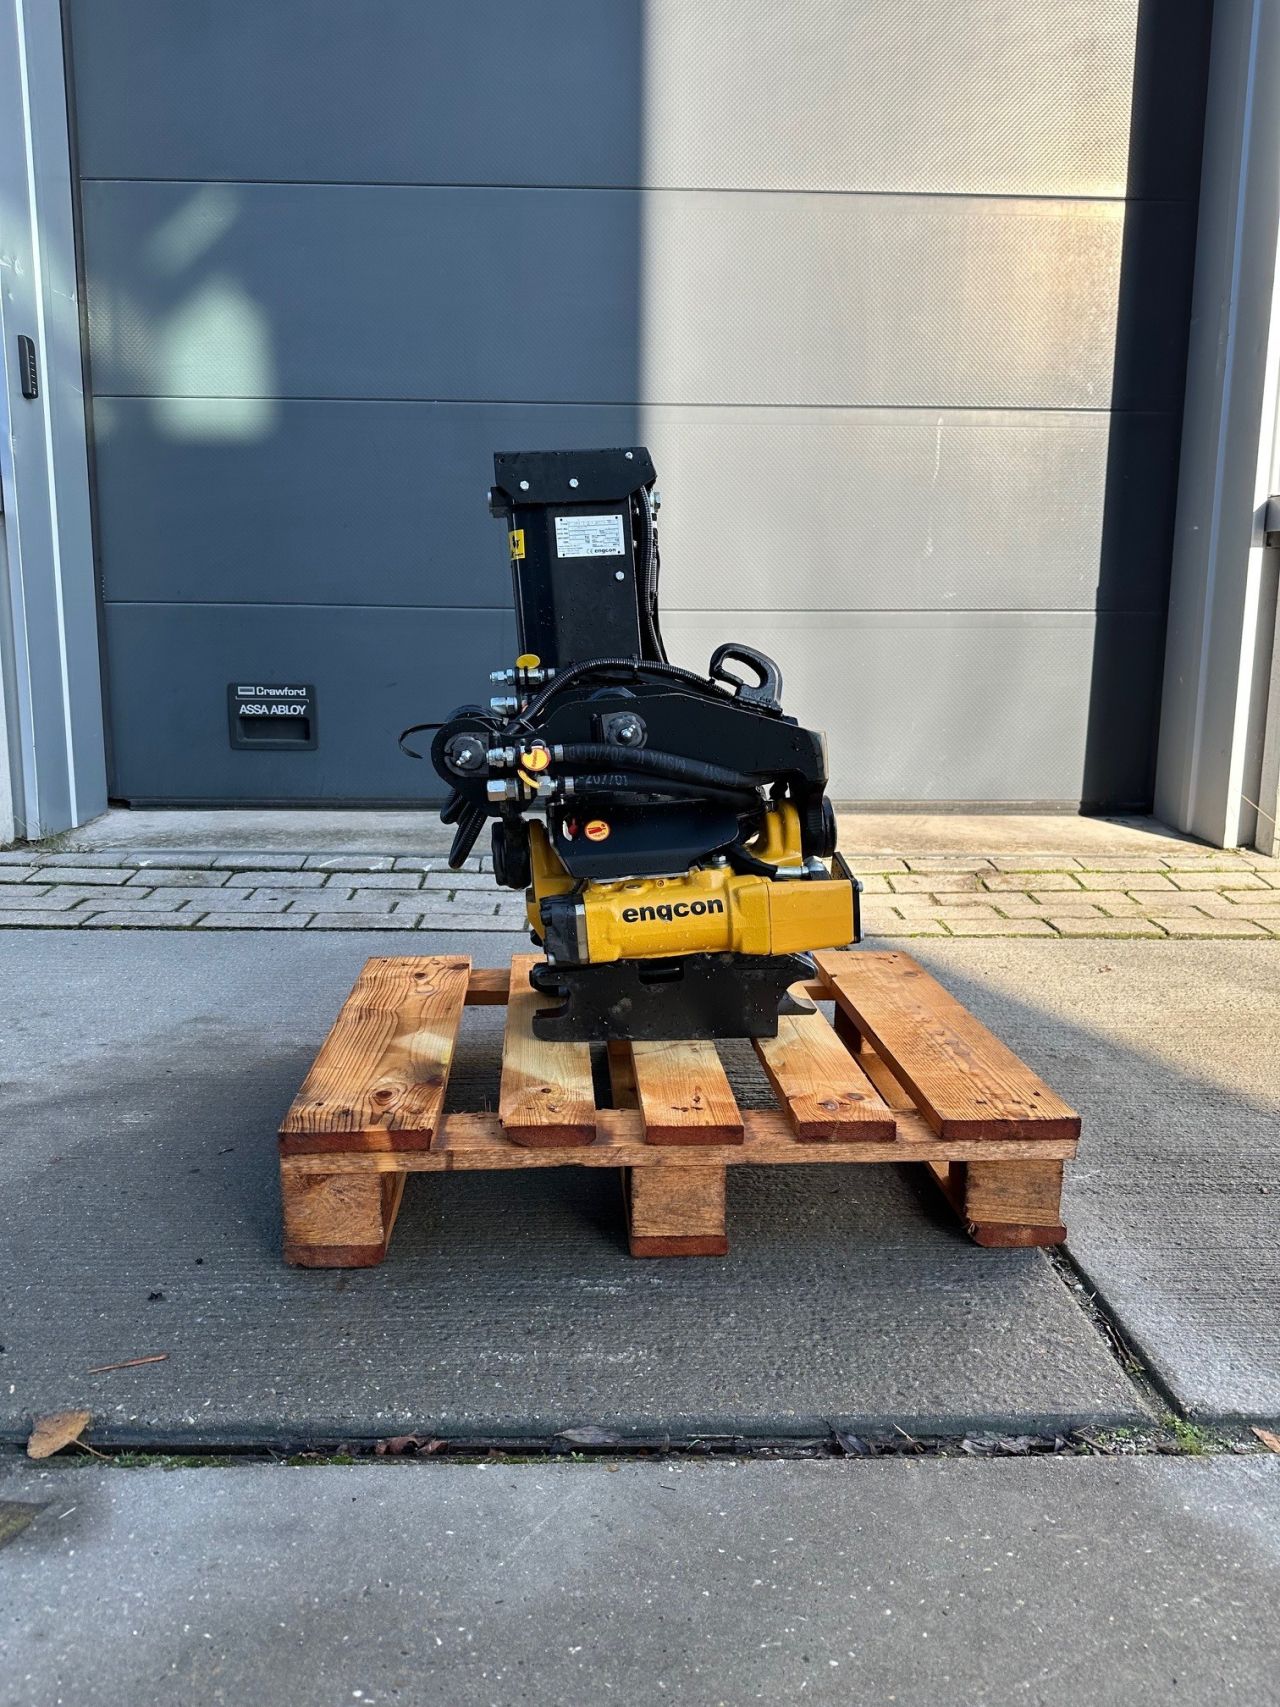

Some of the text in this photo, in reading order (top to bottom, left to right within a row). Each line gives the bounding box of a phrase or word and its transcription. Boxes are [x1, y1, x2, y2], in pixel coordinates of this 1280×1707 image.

[256, 686, 306, 696] Crawford
[239, 704, 307, 715] ASSA ABLOY
